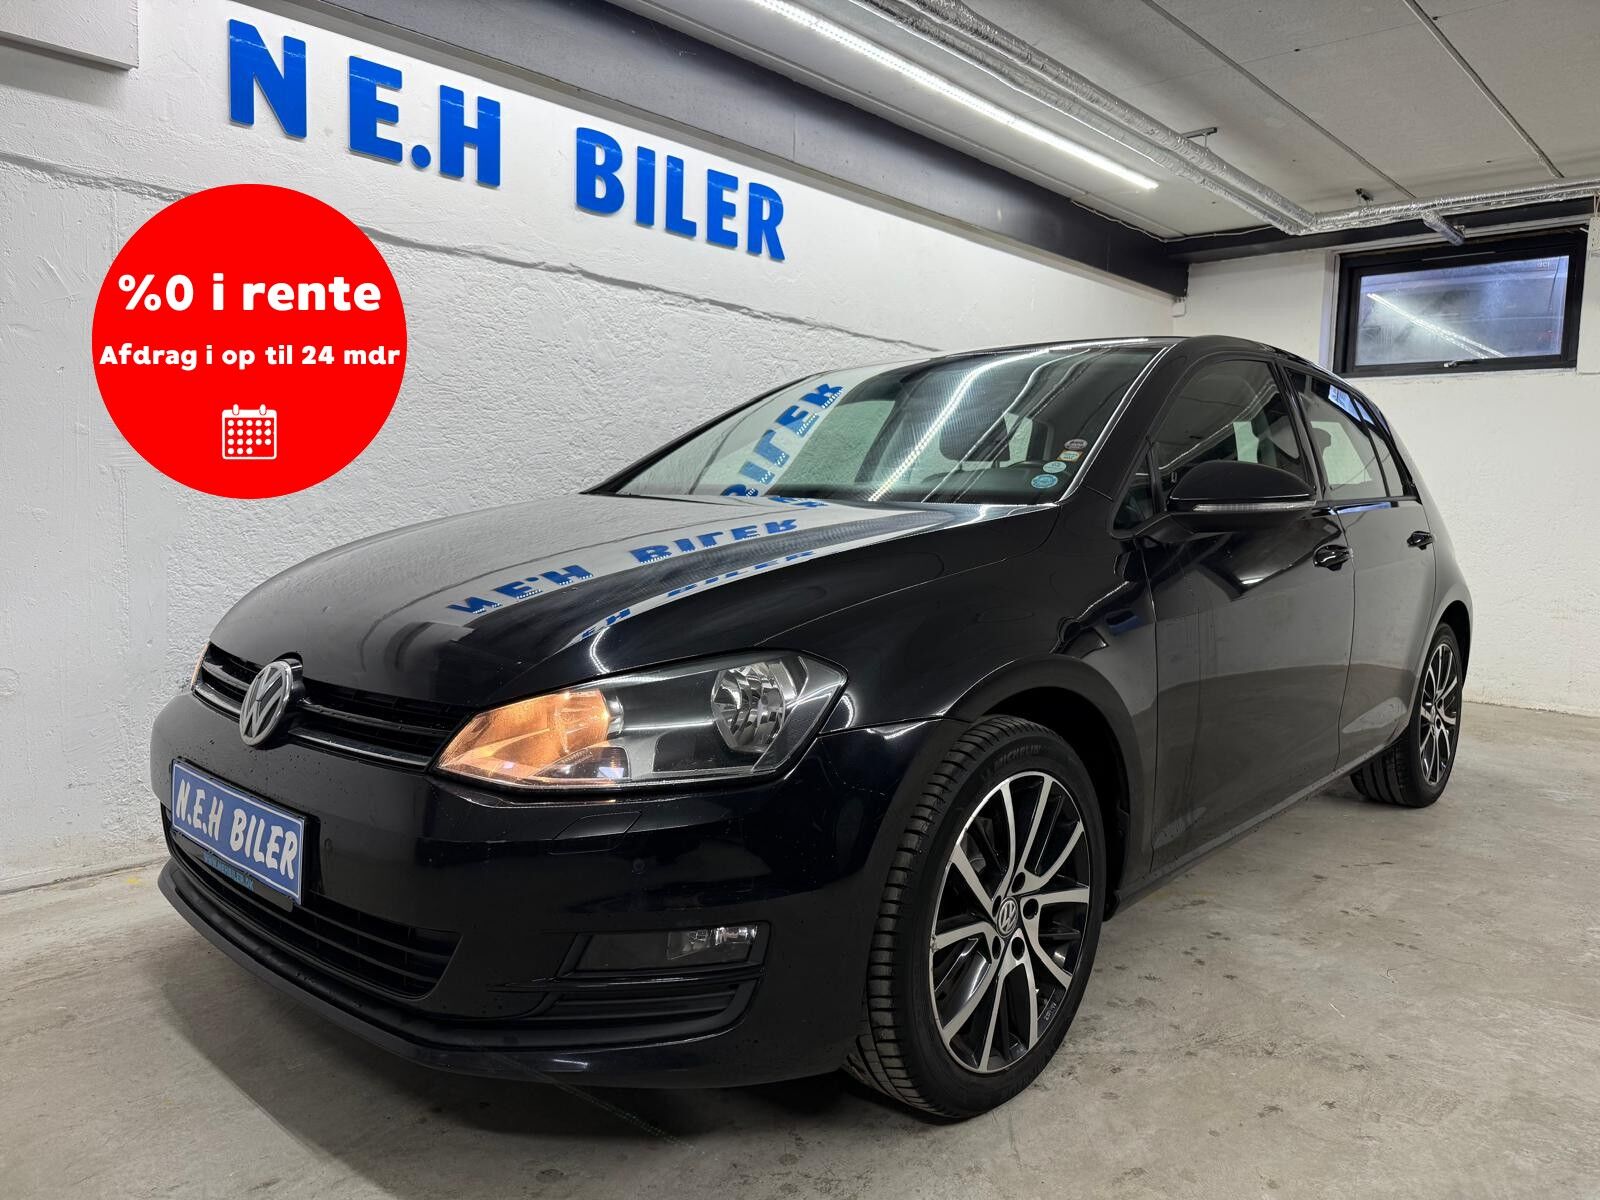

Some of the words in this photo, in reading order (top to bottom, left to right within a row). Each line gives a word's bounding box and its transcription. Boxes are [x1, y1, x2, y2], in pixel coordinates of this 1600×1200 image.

[576, 127, 785, 260] BILER
[175, 778, 224, 841] N.E.H
[229, 808, 298, 880] BILER
